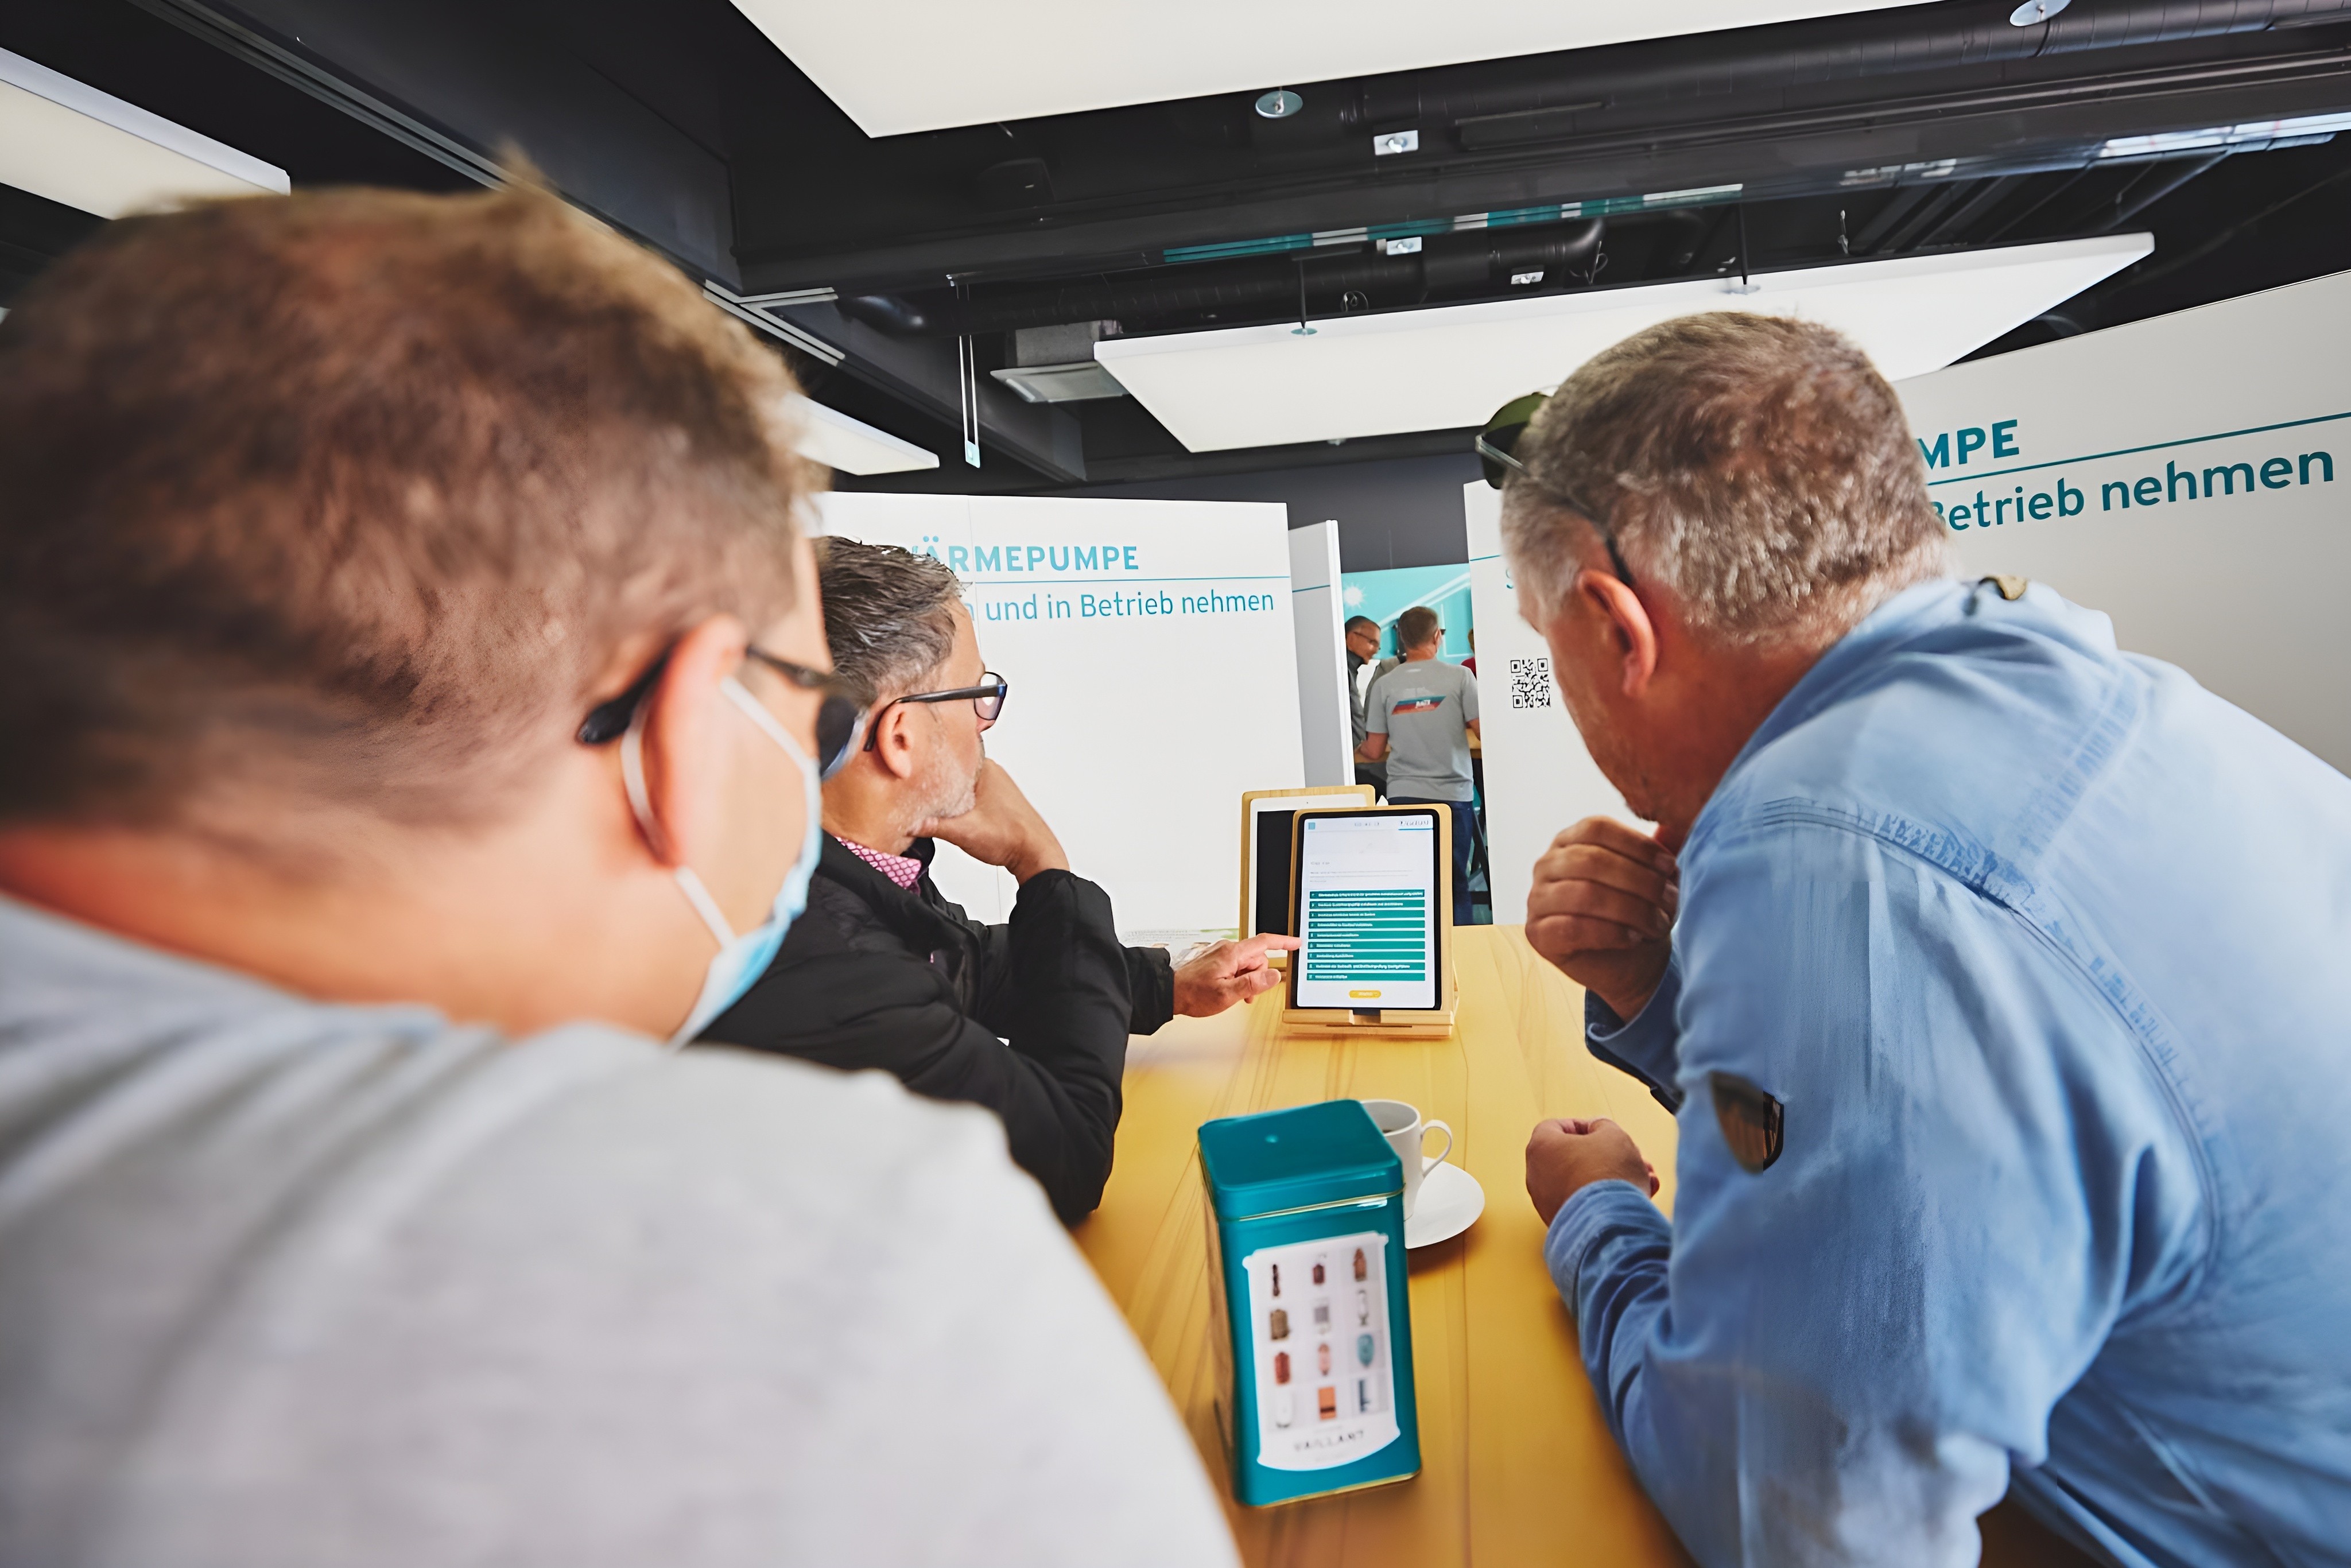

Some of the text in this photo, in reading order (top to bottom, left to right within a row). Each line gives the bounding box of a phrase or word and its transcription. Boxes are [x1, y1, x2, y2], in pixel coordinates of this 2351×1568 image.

[1916, 418, 2020, 469] MPE
[2101, 450, 2334, 511] nehmen
[912, 535, 1139, 572] ÄRMEPUMPE
[985, 593, 1038, 621] und
[1047, 600, 1071, 620] in
[1080, 589, 1174, 618] Betrieb
[1181, 588, 1274, 614] nehmen
